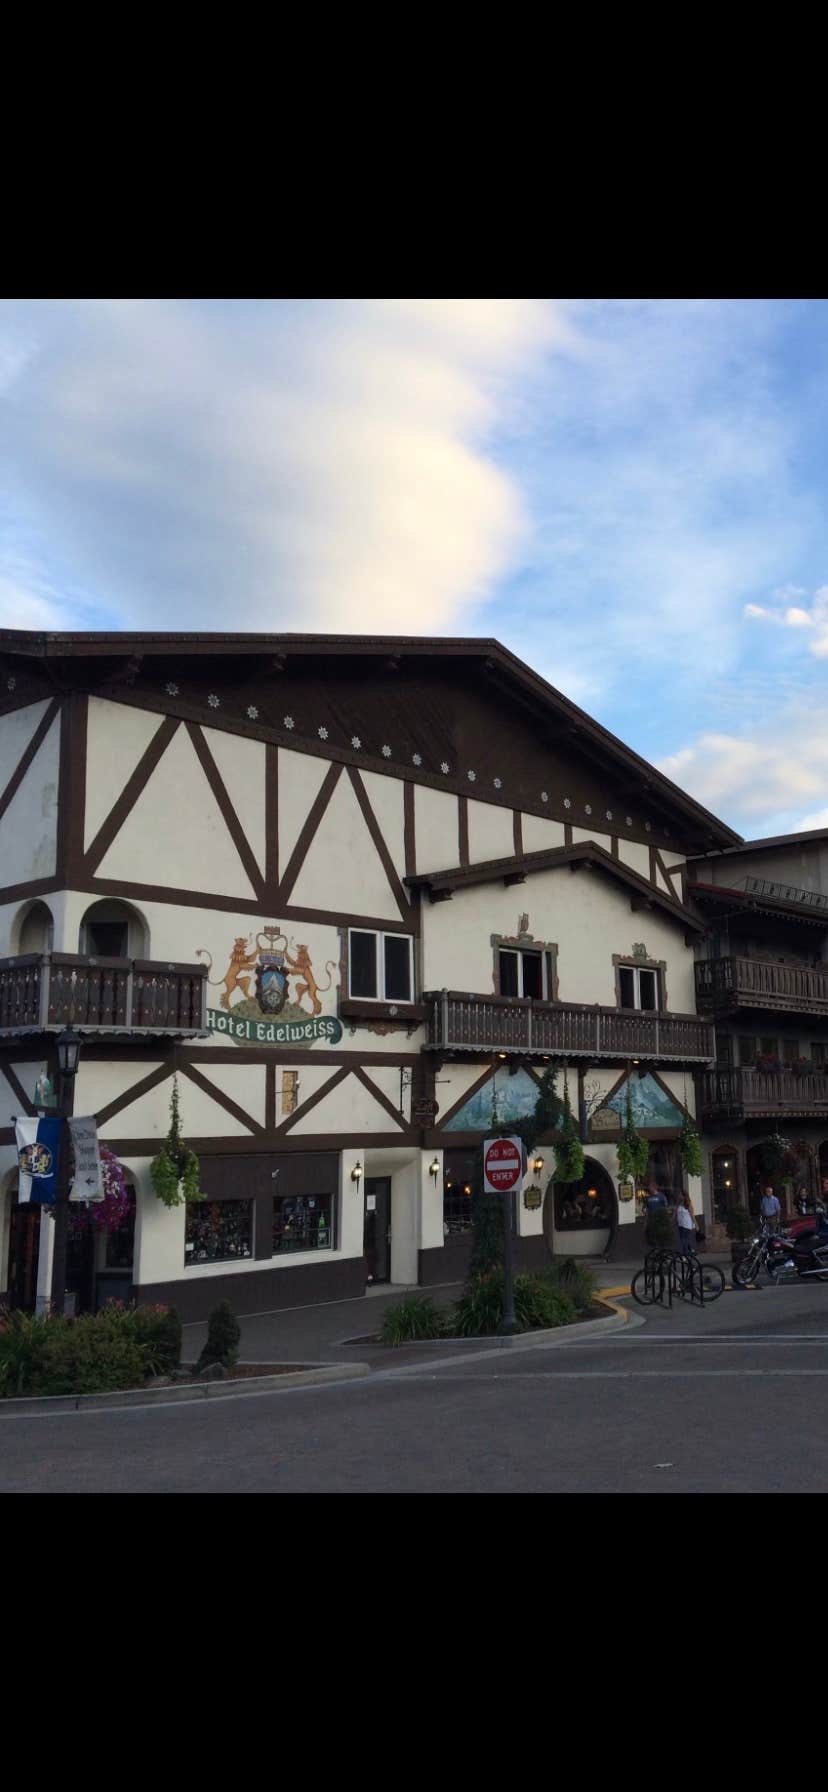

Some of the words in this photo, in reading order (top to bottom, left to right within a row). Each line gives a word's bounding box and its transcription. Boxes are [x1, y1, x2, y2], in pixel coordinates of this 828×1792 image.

[206, 1010, 250, 1038] Hotel
[256, 1020, 335, 1041] Edelweiss
[489, 1149, 499, 1158] DO
[502, 1147, 515, 1157] NOT
[492, 1172, 513, 1181] ENTER
